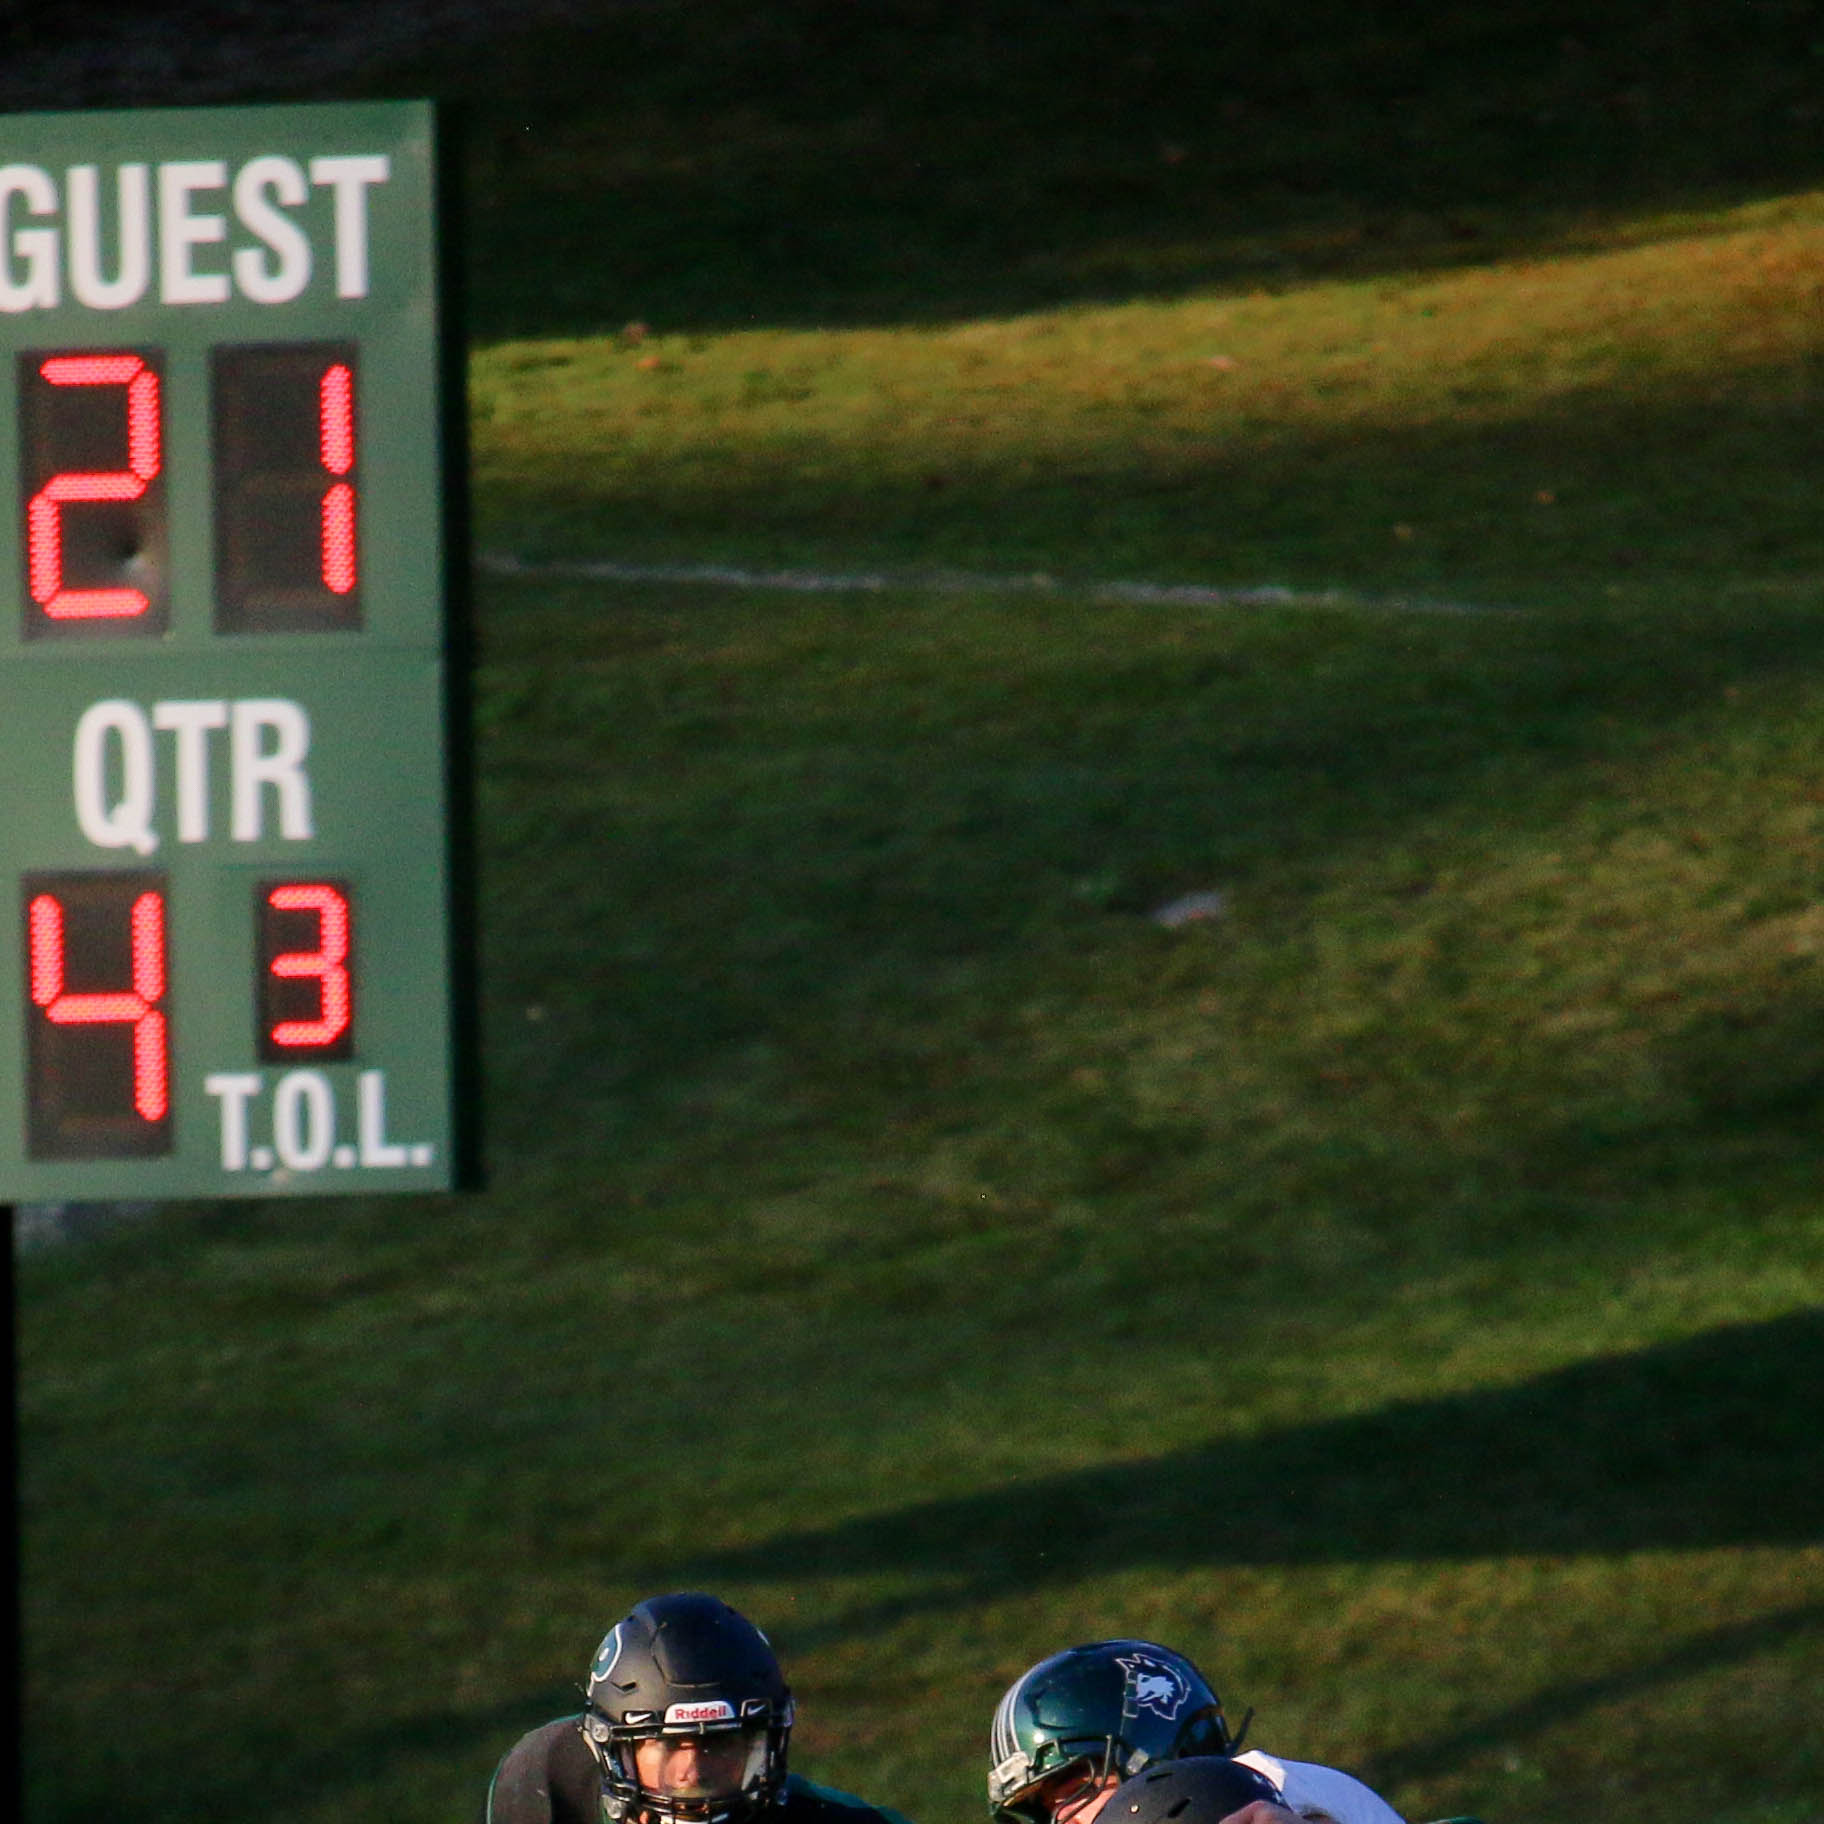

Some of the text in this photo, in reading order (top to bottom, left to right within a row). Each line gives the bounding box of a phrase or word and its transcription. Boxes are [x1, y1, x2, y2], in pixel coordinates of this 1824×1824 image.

[29, 355, 357, 619] 21
[74, 699, 315, 856] QTR
[29, 890, 168, 1122] 4
[268, 883, 350, 1046] 3
[204, 1070, 434, 1172] T.O.L.
